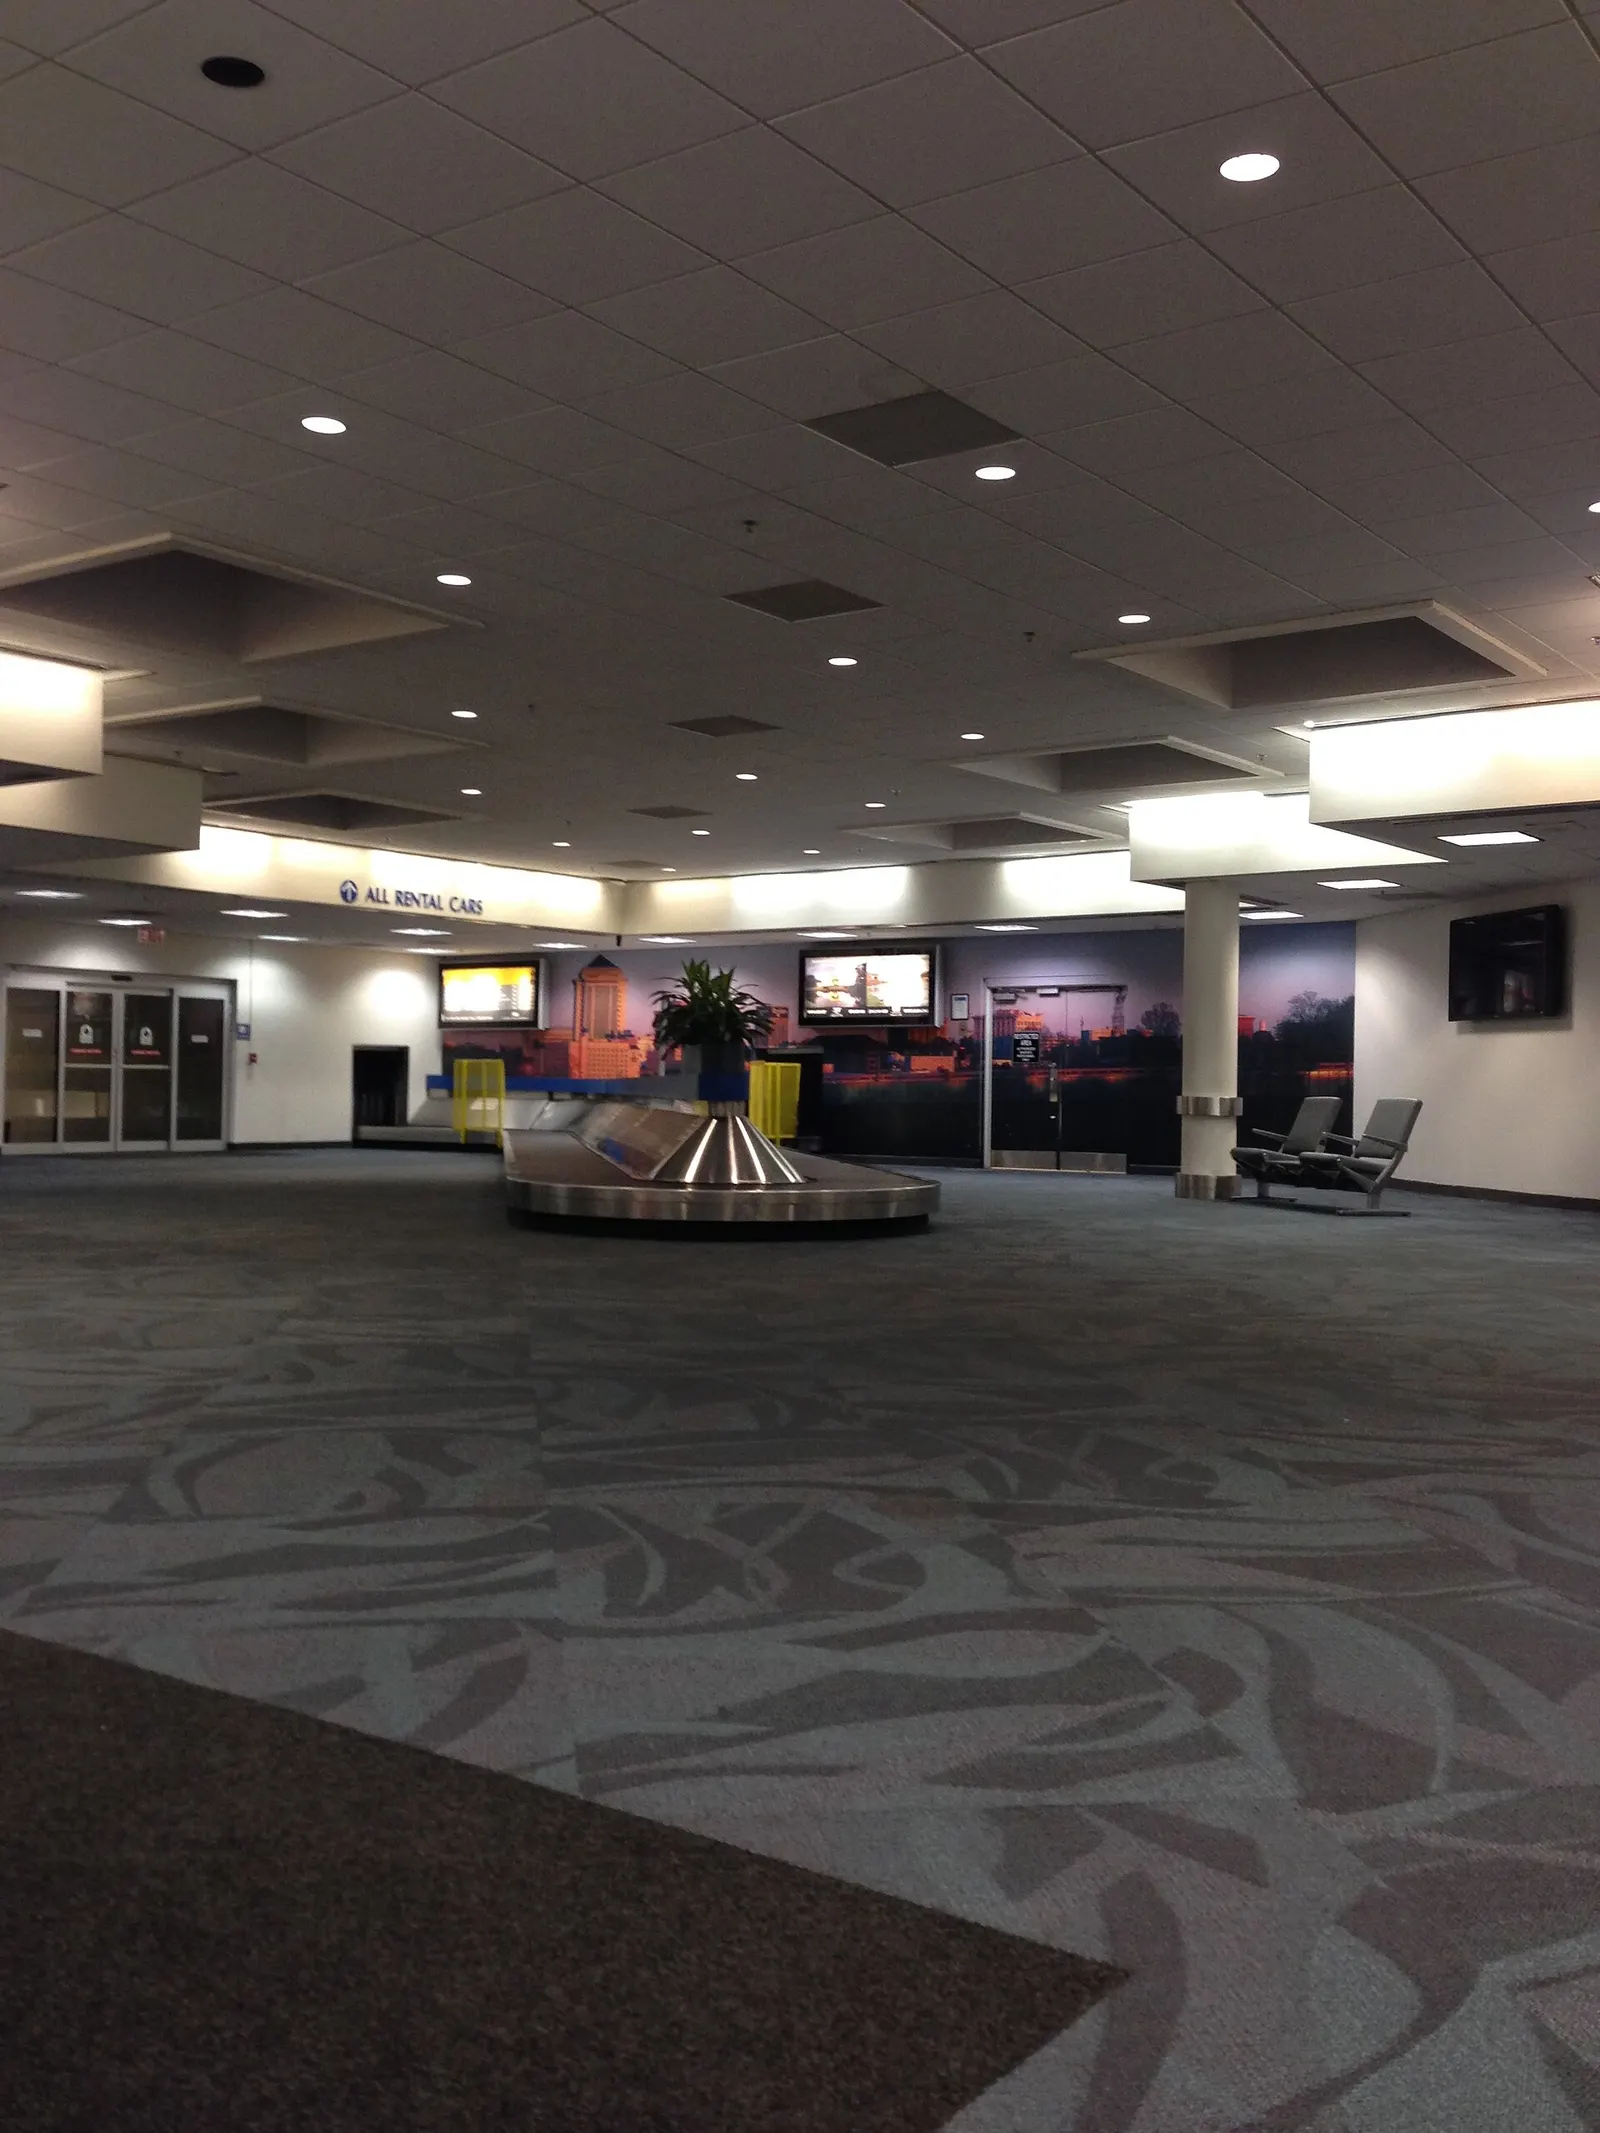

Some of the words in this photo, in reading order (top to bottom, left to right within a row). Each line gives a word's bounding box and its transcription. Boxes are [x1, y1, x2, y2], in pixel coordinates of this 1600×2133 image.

[365, 886, 390, 904] ALL
[395, 889, 444, 911] RENTAL
[449, 896, 483, 915] CARS
